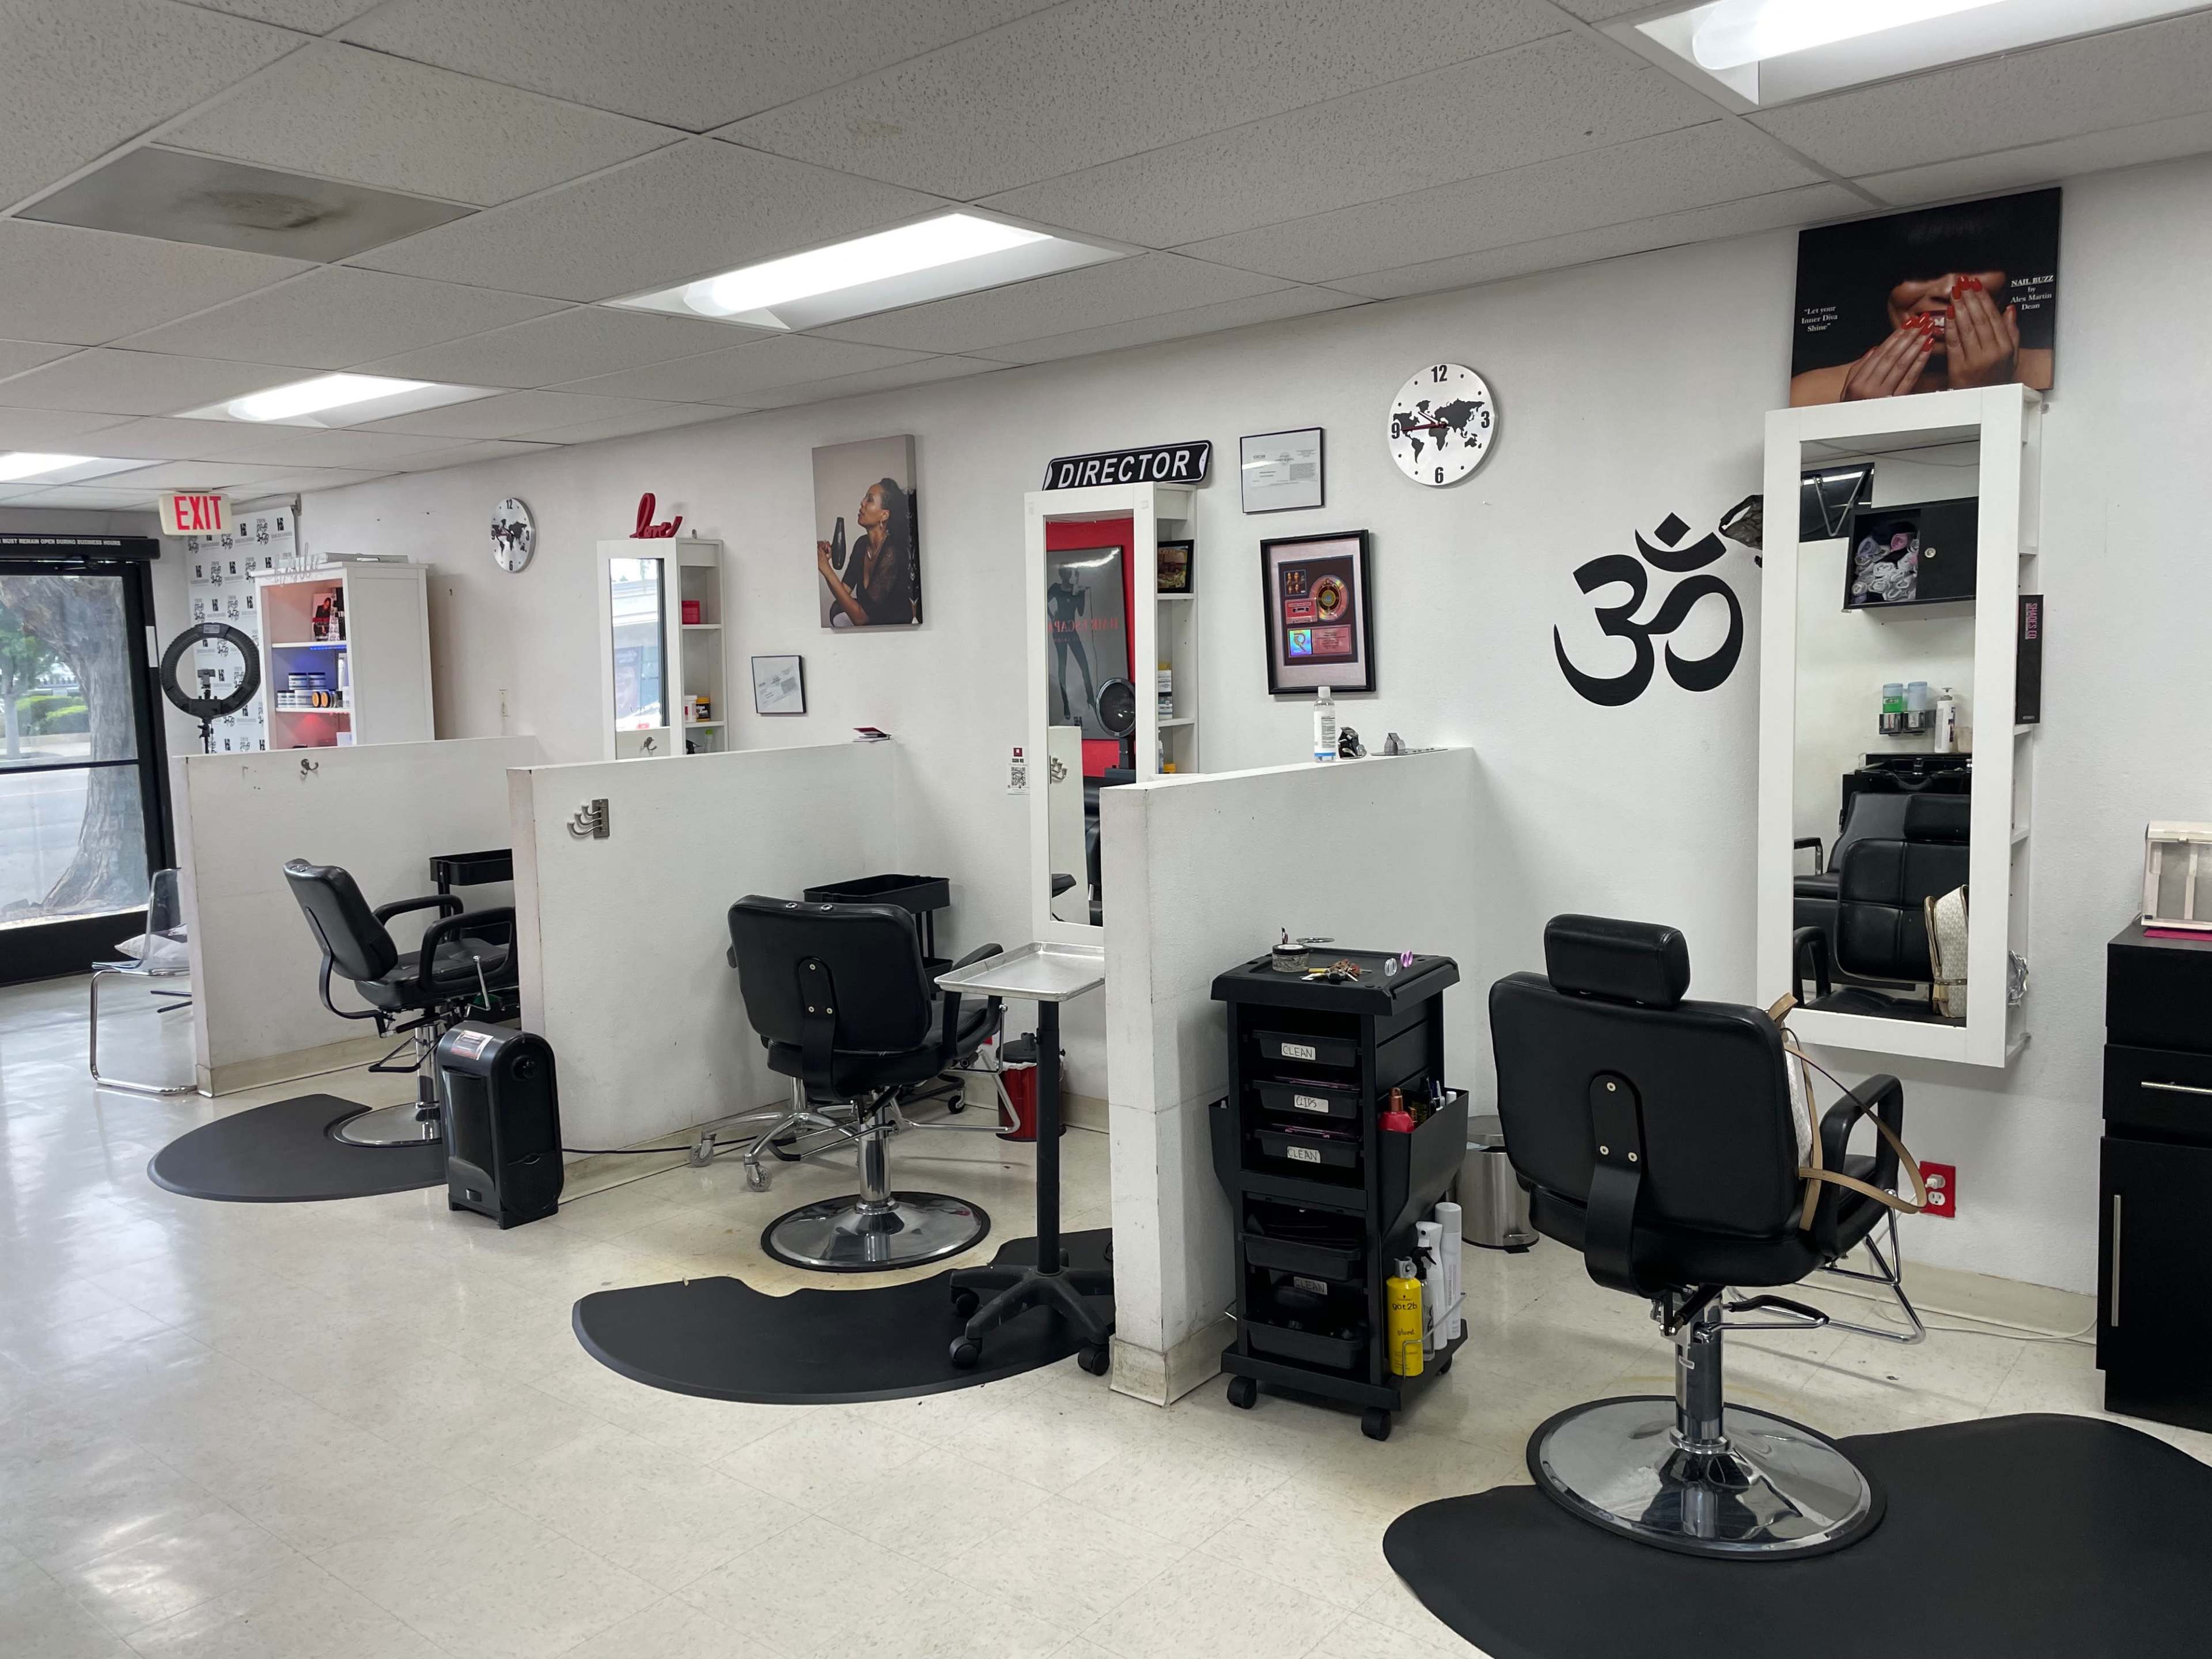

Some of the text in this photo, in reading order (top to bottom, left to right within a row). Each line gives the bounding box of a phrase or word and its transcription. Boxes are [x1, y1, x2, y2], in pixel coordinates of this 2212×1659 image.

[2010, 275, 2054, 287] NAIL BUZZ
[2028, 293, 2052, 301] Martin
[1820, 306, 1836, 315] your
[1431, 365, 1448, 382] 12
[1391, 411, 1490, 439] 9 3
[1058, 450, 1190, 488] DIRECTOR
[1434, 467, 1444, 483] 6
[506, 499, 513, 509] 12
[174, 496, 222, 530] EXIT
[526, 530, 530, 541] 3
[509, 560, 513, 570] 6
[1283, 1046, 1313, 1058] CLEAN
[1296, 1096, 1317, 1107] CLIPS
[1287, 1148, 1317, 1161] CLEAN
[1295, 1278, 1324, 1292] CLEAN
